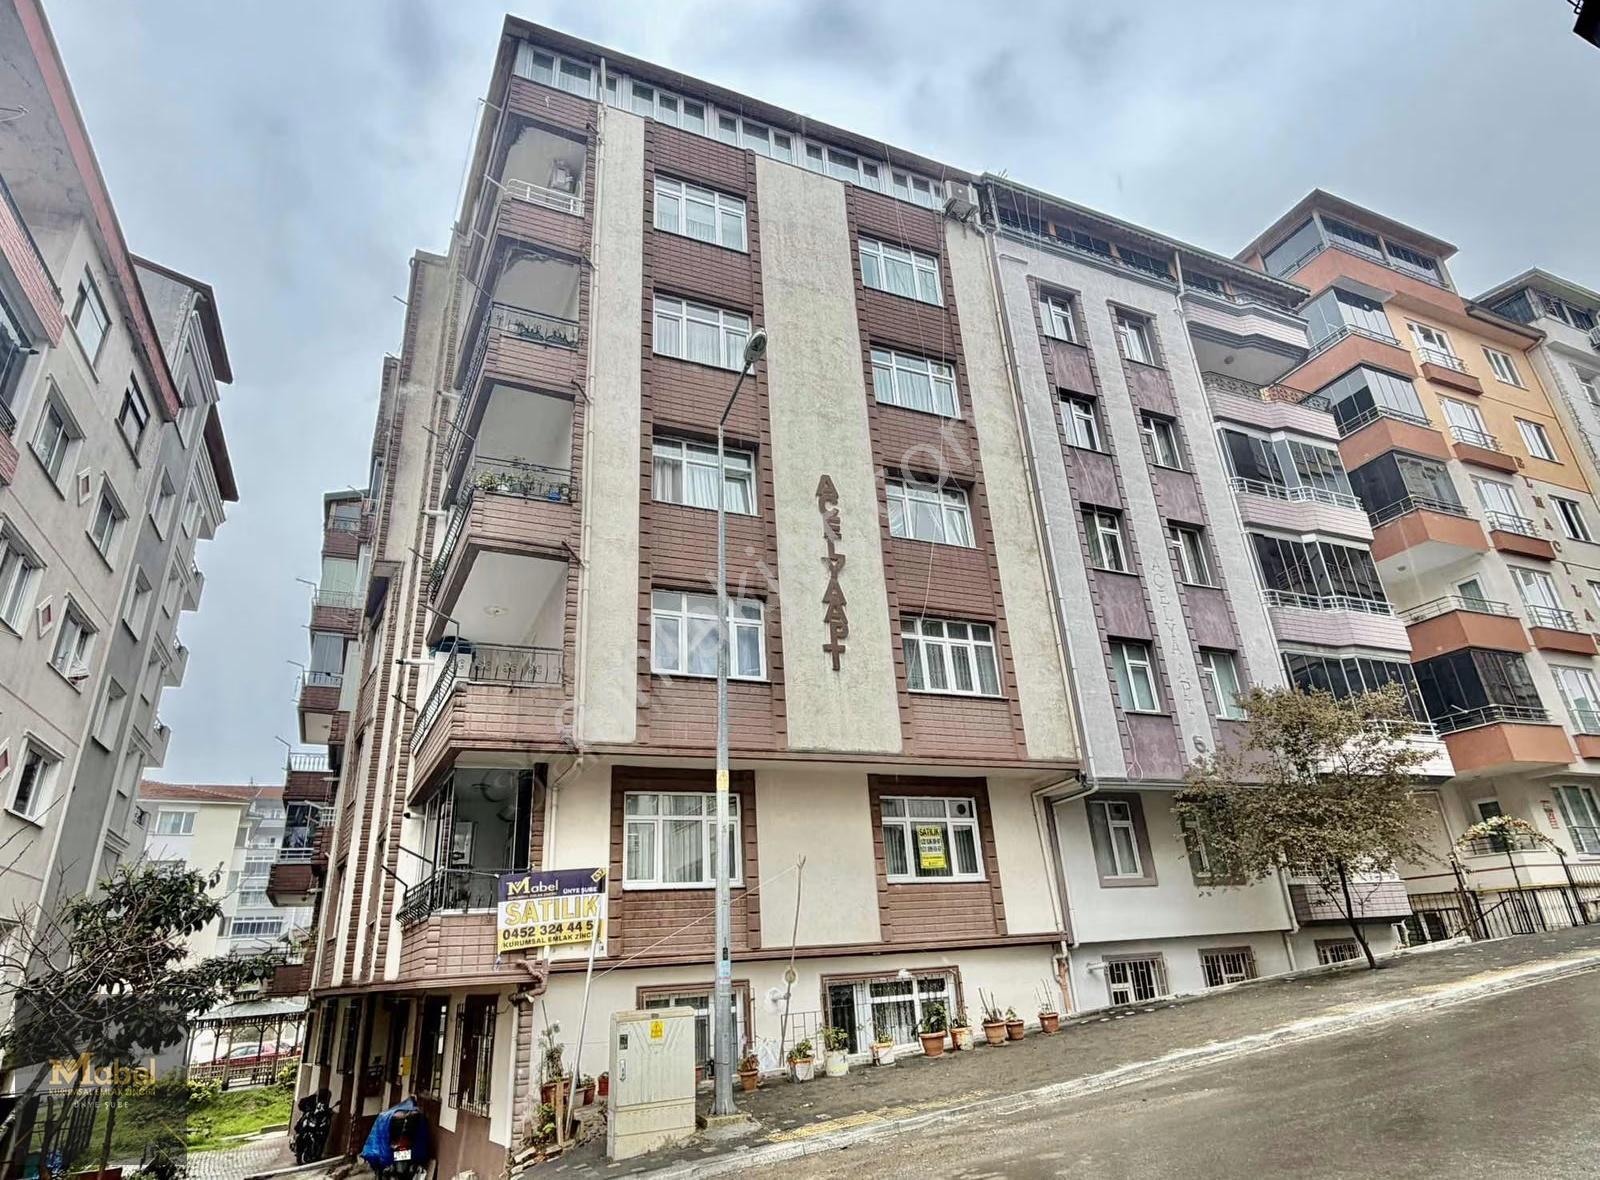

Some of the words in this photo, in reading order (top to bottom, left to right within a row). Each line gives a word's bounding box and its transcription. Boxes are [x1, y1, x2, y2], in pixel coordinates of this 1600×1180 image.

[1192, 735, 1206, 753] 6
[506, 876, 558, 895] Mabel
[506, 895, 599, 925] SATILIK
[503, 926, 536, 940] 0452
[540, 922, 564, 936] 324
[567, 921, 583, 932] 44
[503, 939, 545, 948] KURUMSAL
[548, 933, 573, 943] EMLAK
